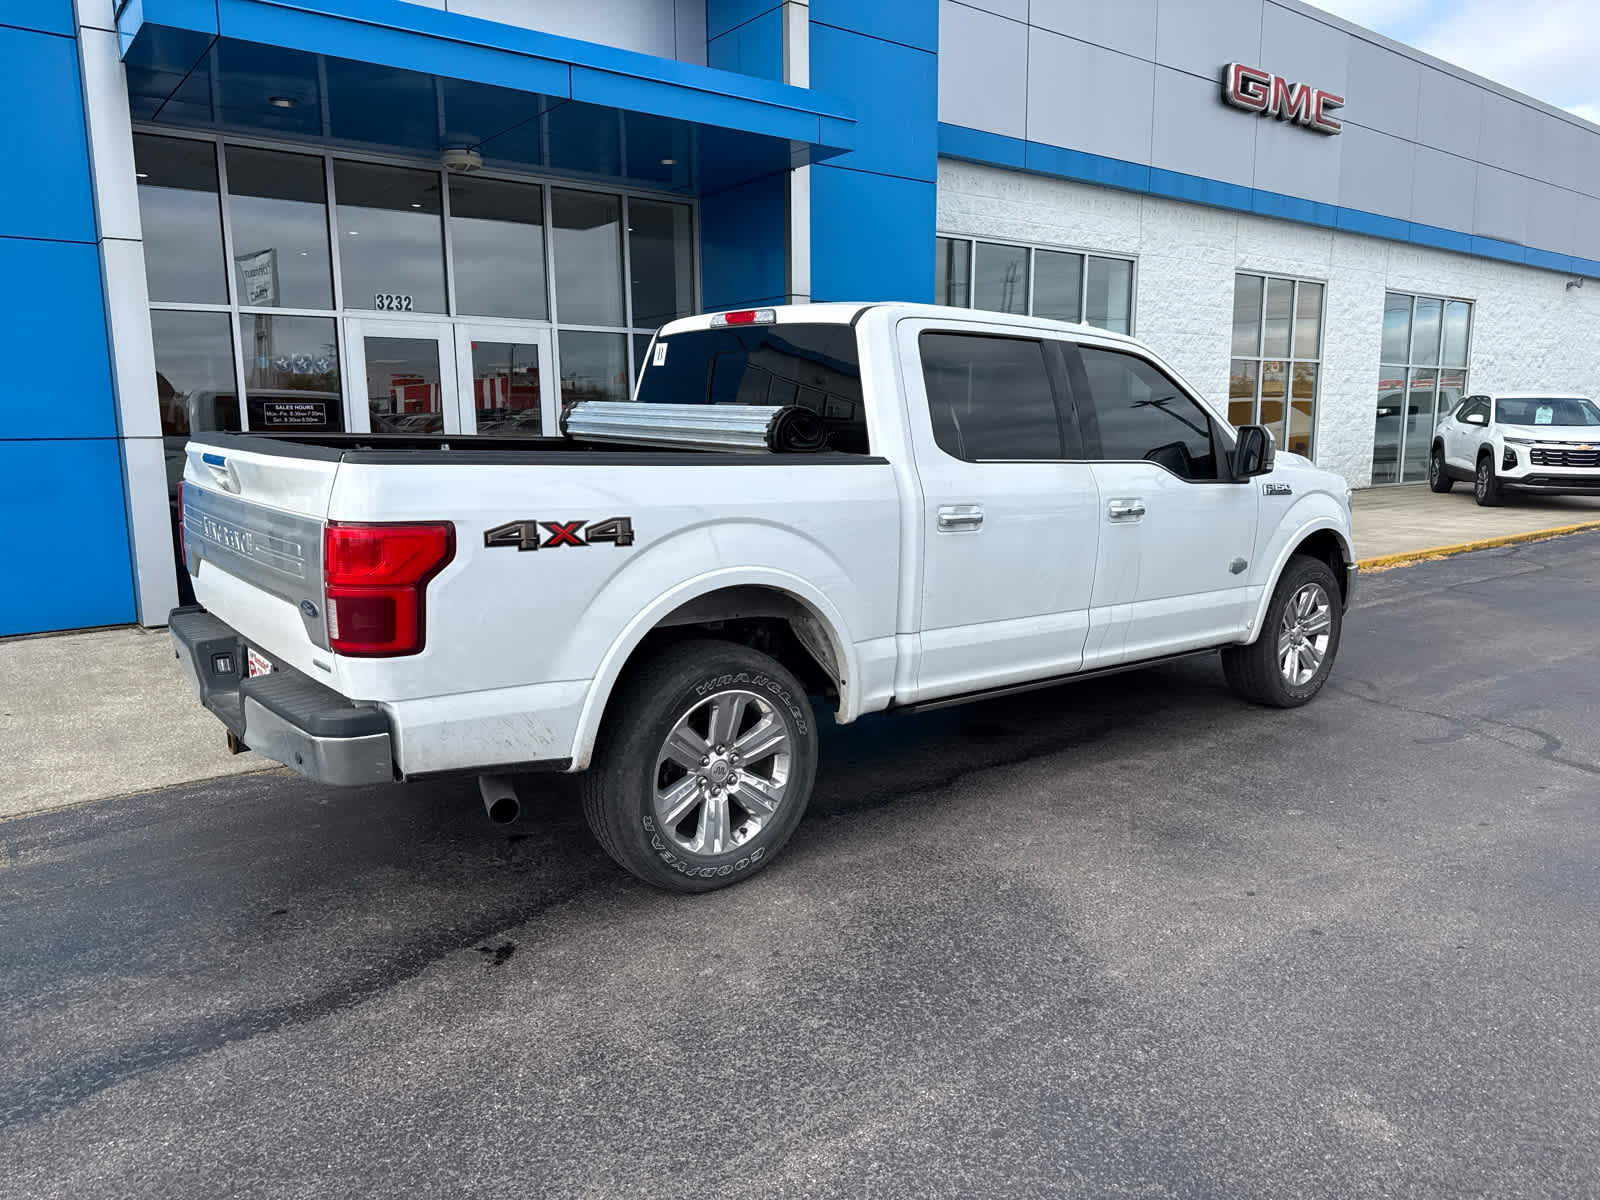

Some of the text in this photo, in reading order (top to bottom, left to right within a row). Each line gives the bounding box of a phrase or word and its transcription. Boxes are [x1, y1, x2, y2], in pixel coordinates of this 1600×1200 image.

[1223, 62, 1345, 136] GMC
[376, 294, 412, 312] 3232
[695, 672, 808, 736] WRANGLER
[642, 815, 766, 878] GOODYEAR
